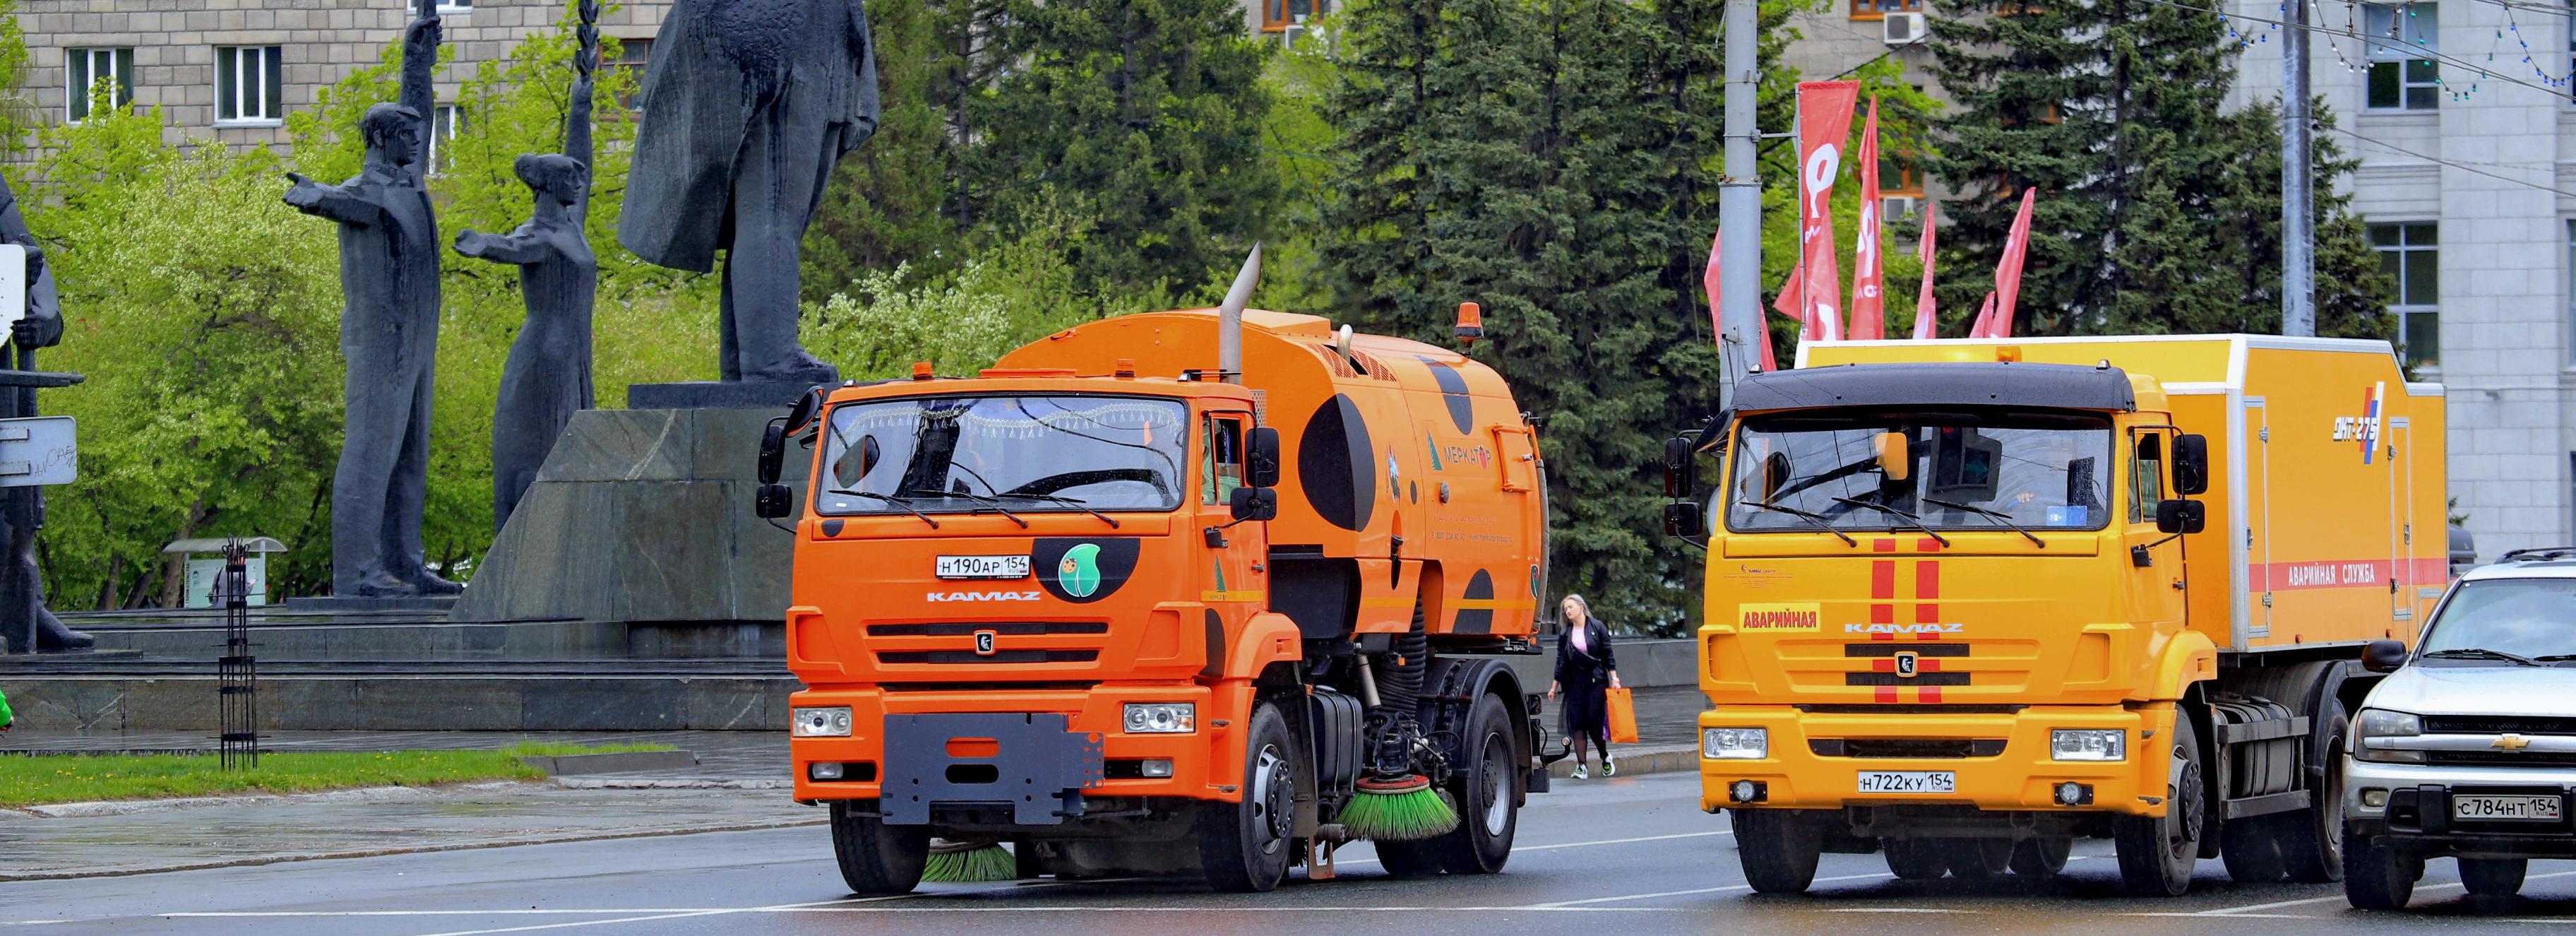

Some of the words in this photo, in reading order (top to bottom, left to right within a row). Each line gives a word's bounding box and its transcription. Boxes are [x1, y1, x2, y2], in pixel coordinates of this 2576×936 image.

[942, 558, 1000, 574] Н190АР
[1004, 557, 1027, 569] 154
[2288, 562, 2336, 586] АВАРИЙНАЯ
[2342, 563, 2375, 584] СЛУЖБА
[926, 591, 1041, 602] KAMAZ
[1743, 608, 1817, 629] АВАРИЙНАЯ
[1844, 623, 1963, 634] KAMAZ
[1863, 774, 1924, 790] Н722КУ
[1927, 774, 1952, 786] 154
[2460, 799, 2527, 816] С784НТ
[2530, 799, 2557, 812] 154
